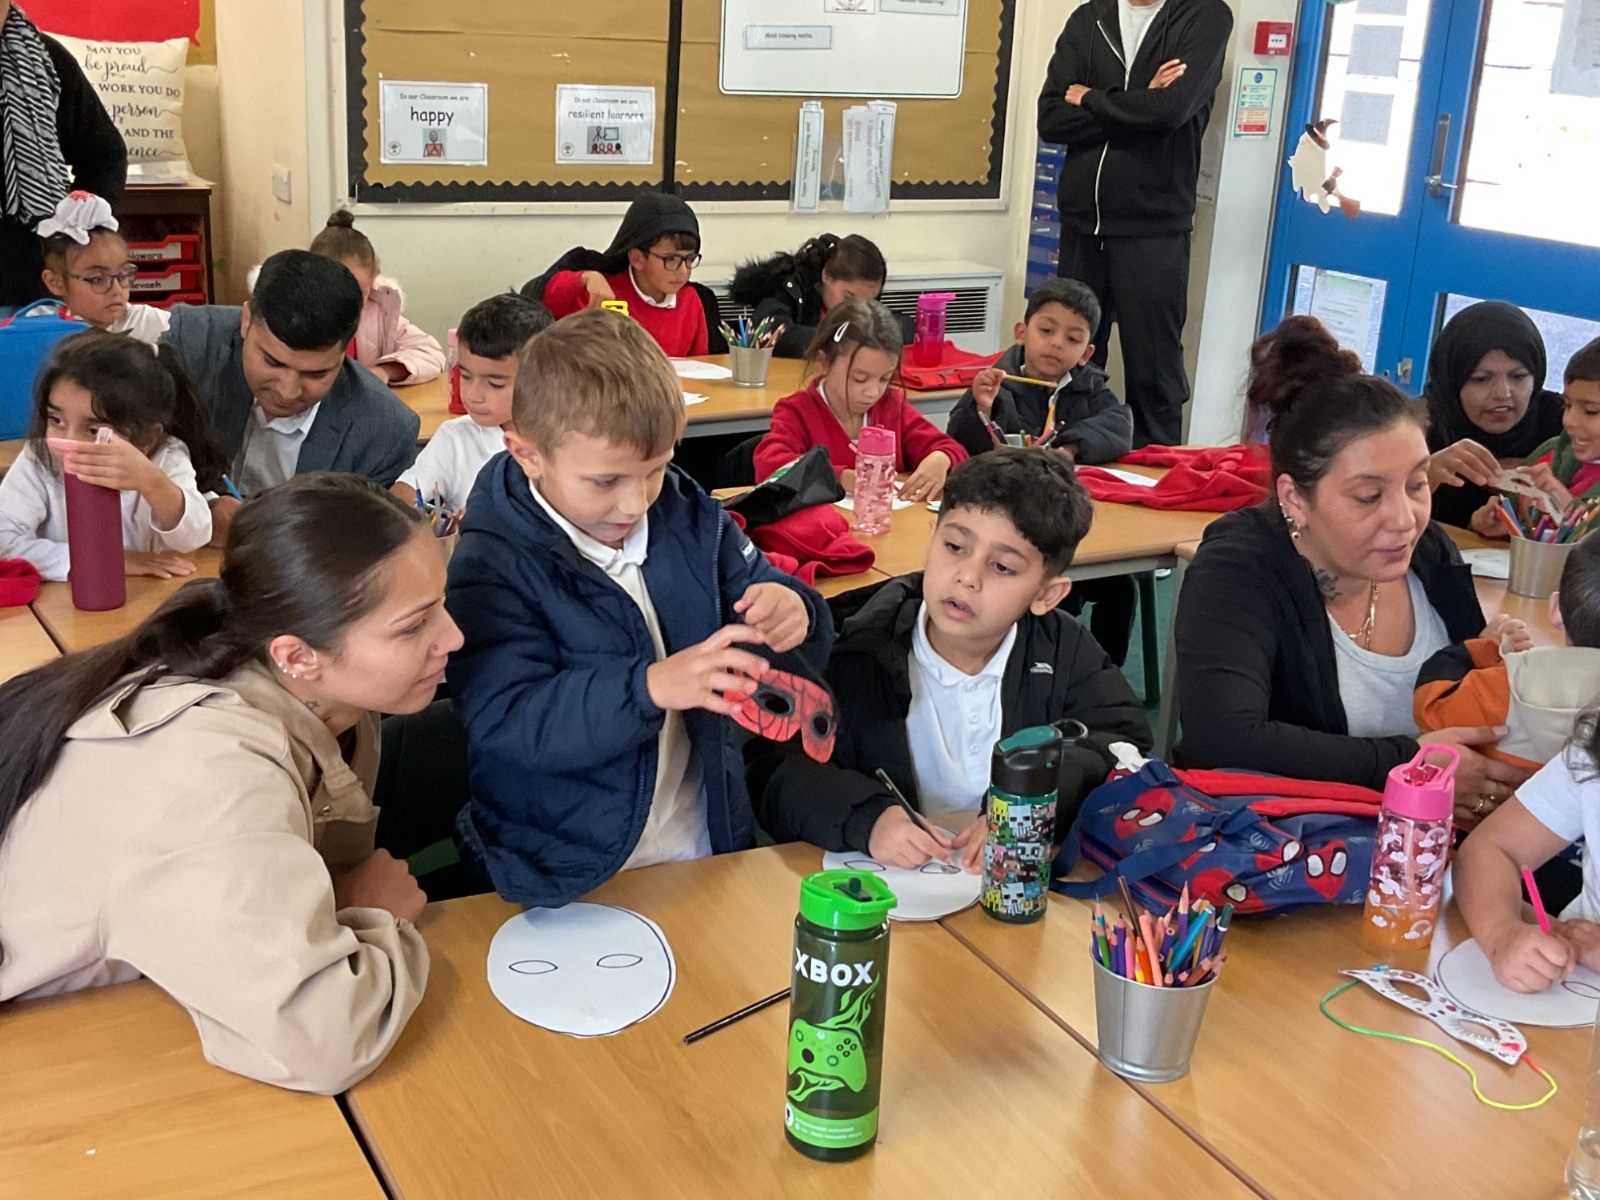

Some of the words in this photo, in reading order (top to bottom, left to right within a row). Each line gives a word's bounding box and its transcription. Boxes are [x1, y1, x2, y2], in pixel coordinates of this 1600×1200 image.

[86, 45, 112, 55] MAY
[116, 47, 141, 55] YOU
[84, 54, 102, 70] be
[102, 56, 164, 82] proud
[98, 83, 136, 94] WORK
[138, 85, 163, 95] YOU
[166, 87, 181, 98] DO
[111, 102, 171, 123] person
[410, 106, 454, 126] happy
[568, 109, 605, 119] resilient
[608, 109, 644, 120] learners
[124, 128, 150, 138] AND
[152, 128, 174, 138] THE
[128, 146, 168, 158] ence
[131, 280, 162, 289] evaeh
[794, 946, 874, 987] XBOX
